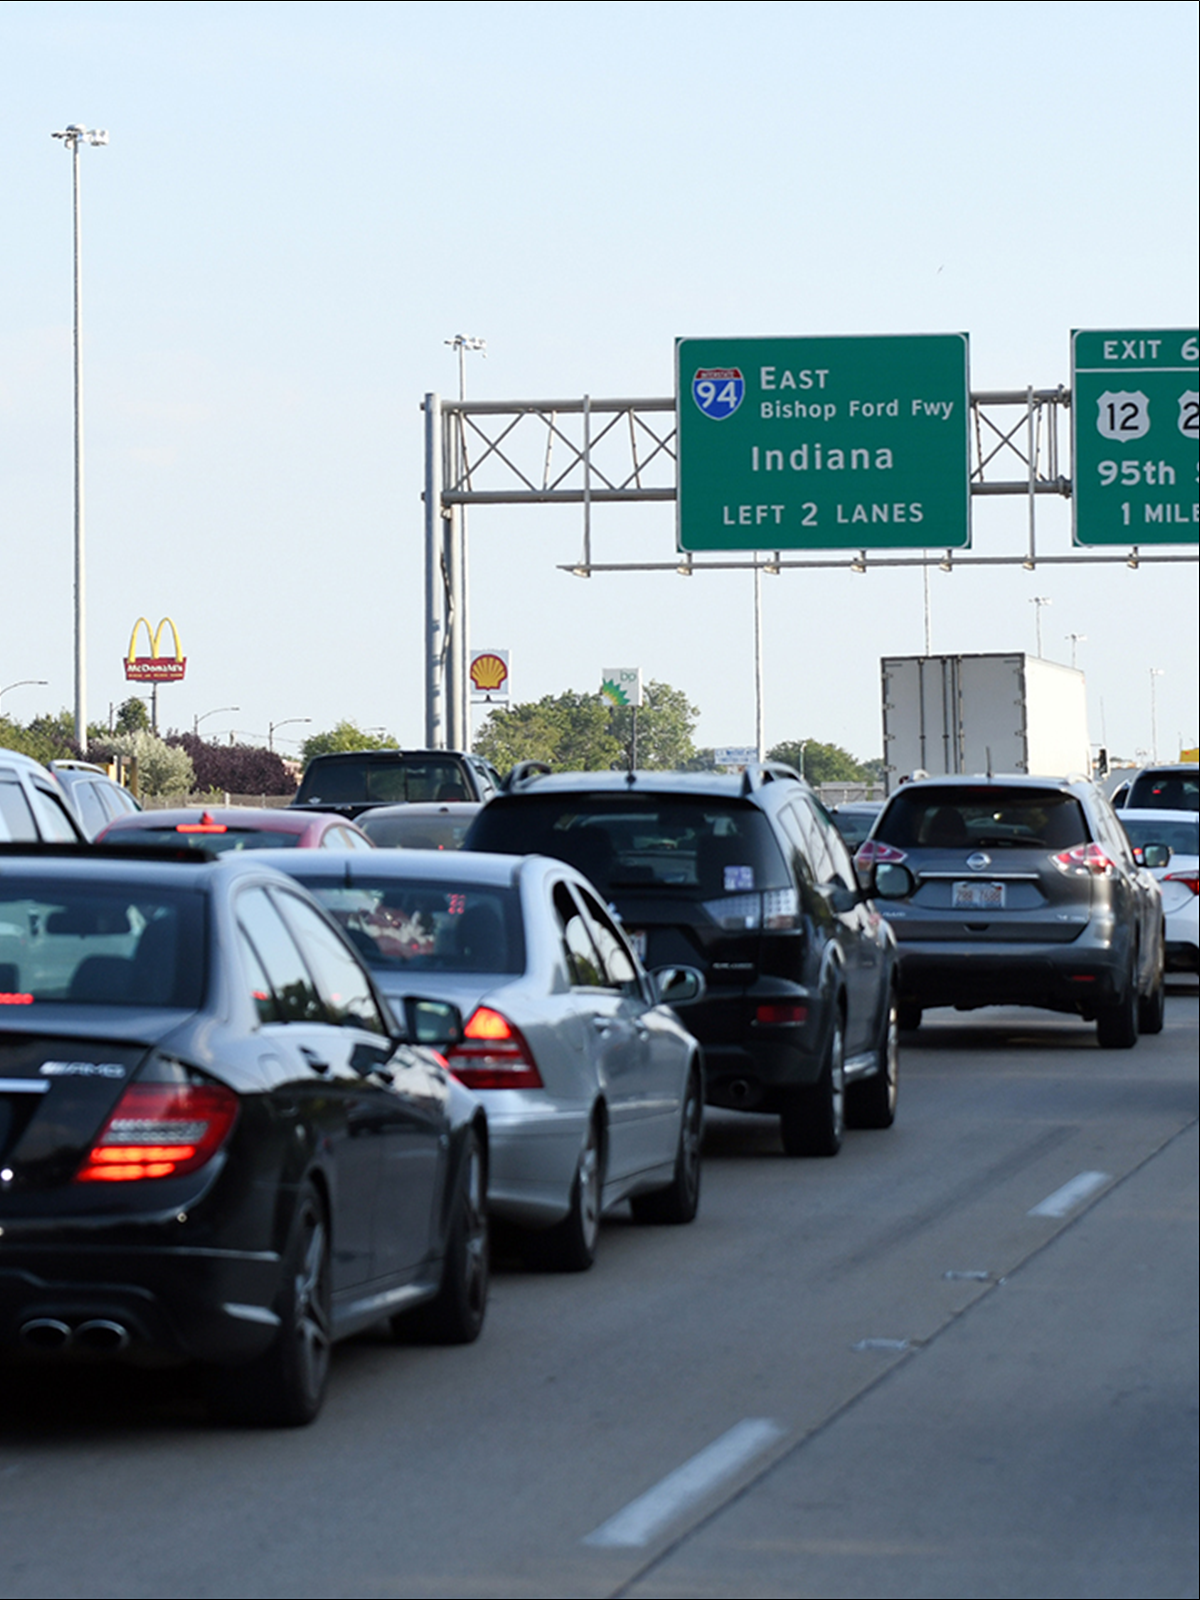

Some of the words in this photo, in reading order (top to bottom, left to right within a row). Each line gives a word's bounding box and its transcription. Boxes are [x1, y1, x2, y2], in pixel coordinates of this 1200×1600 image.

[1104, 340, 1161, 359] EXIT
[761, 367, 829, 389] EAST
[697, 381, 738, 409] 94
[761, 401, 836, 421] Bishop
[850, 399, 898, 416] Ford
[912, 400, 953, 420] Fwy
[1107, 403, 1139, 430] 12
[753, 443, 892, 471] Indiana
[1098, 461, 1175, 485] 95th
[724, 505, 784, 524] LEFT
[802, 503, 817, 526] 2
[838, 503, 923, 523] LANES
[1122, 503, 1129, 525] 1
[127, 664, 183, 672] McDonald's
[620, 669, 637, 684] bp
